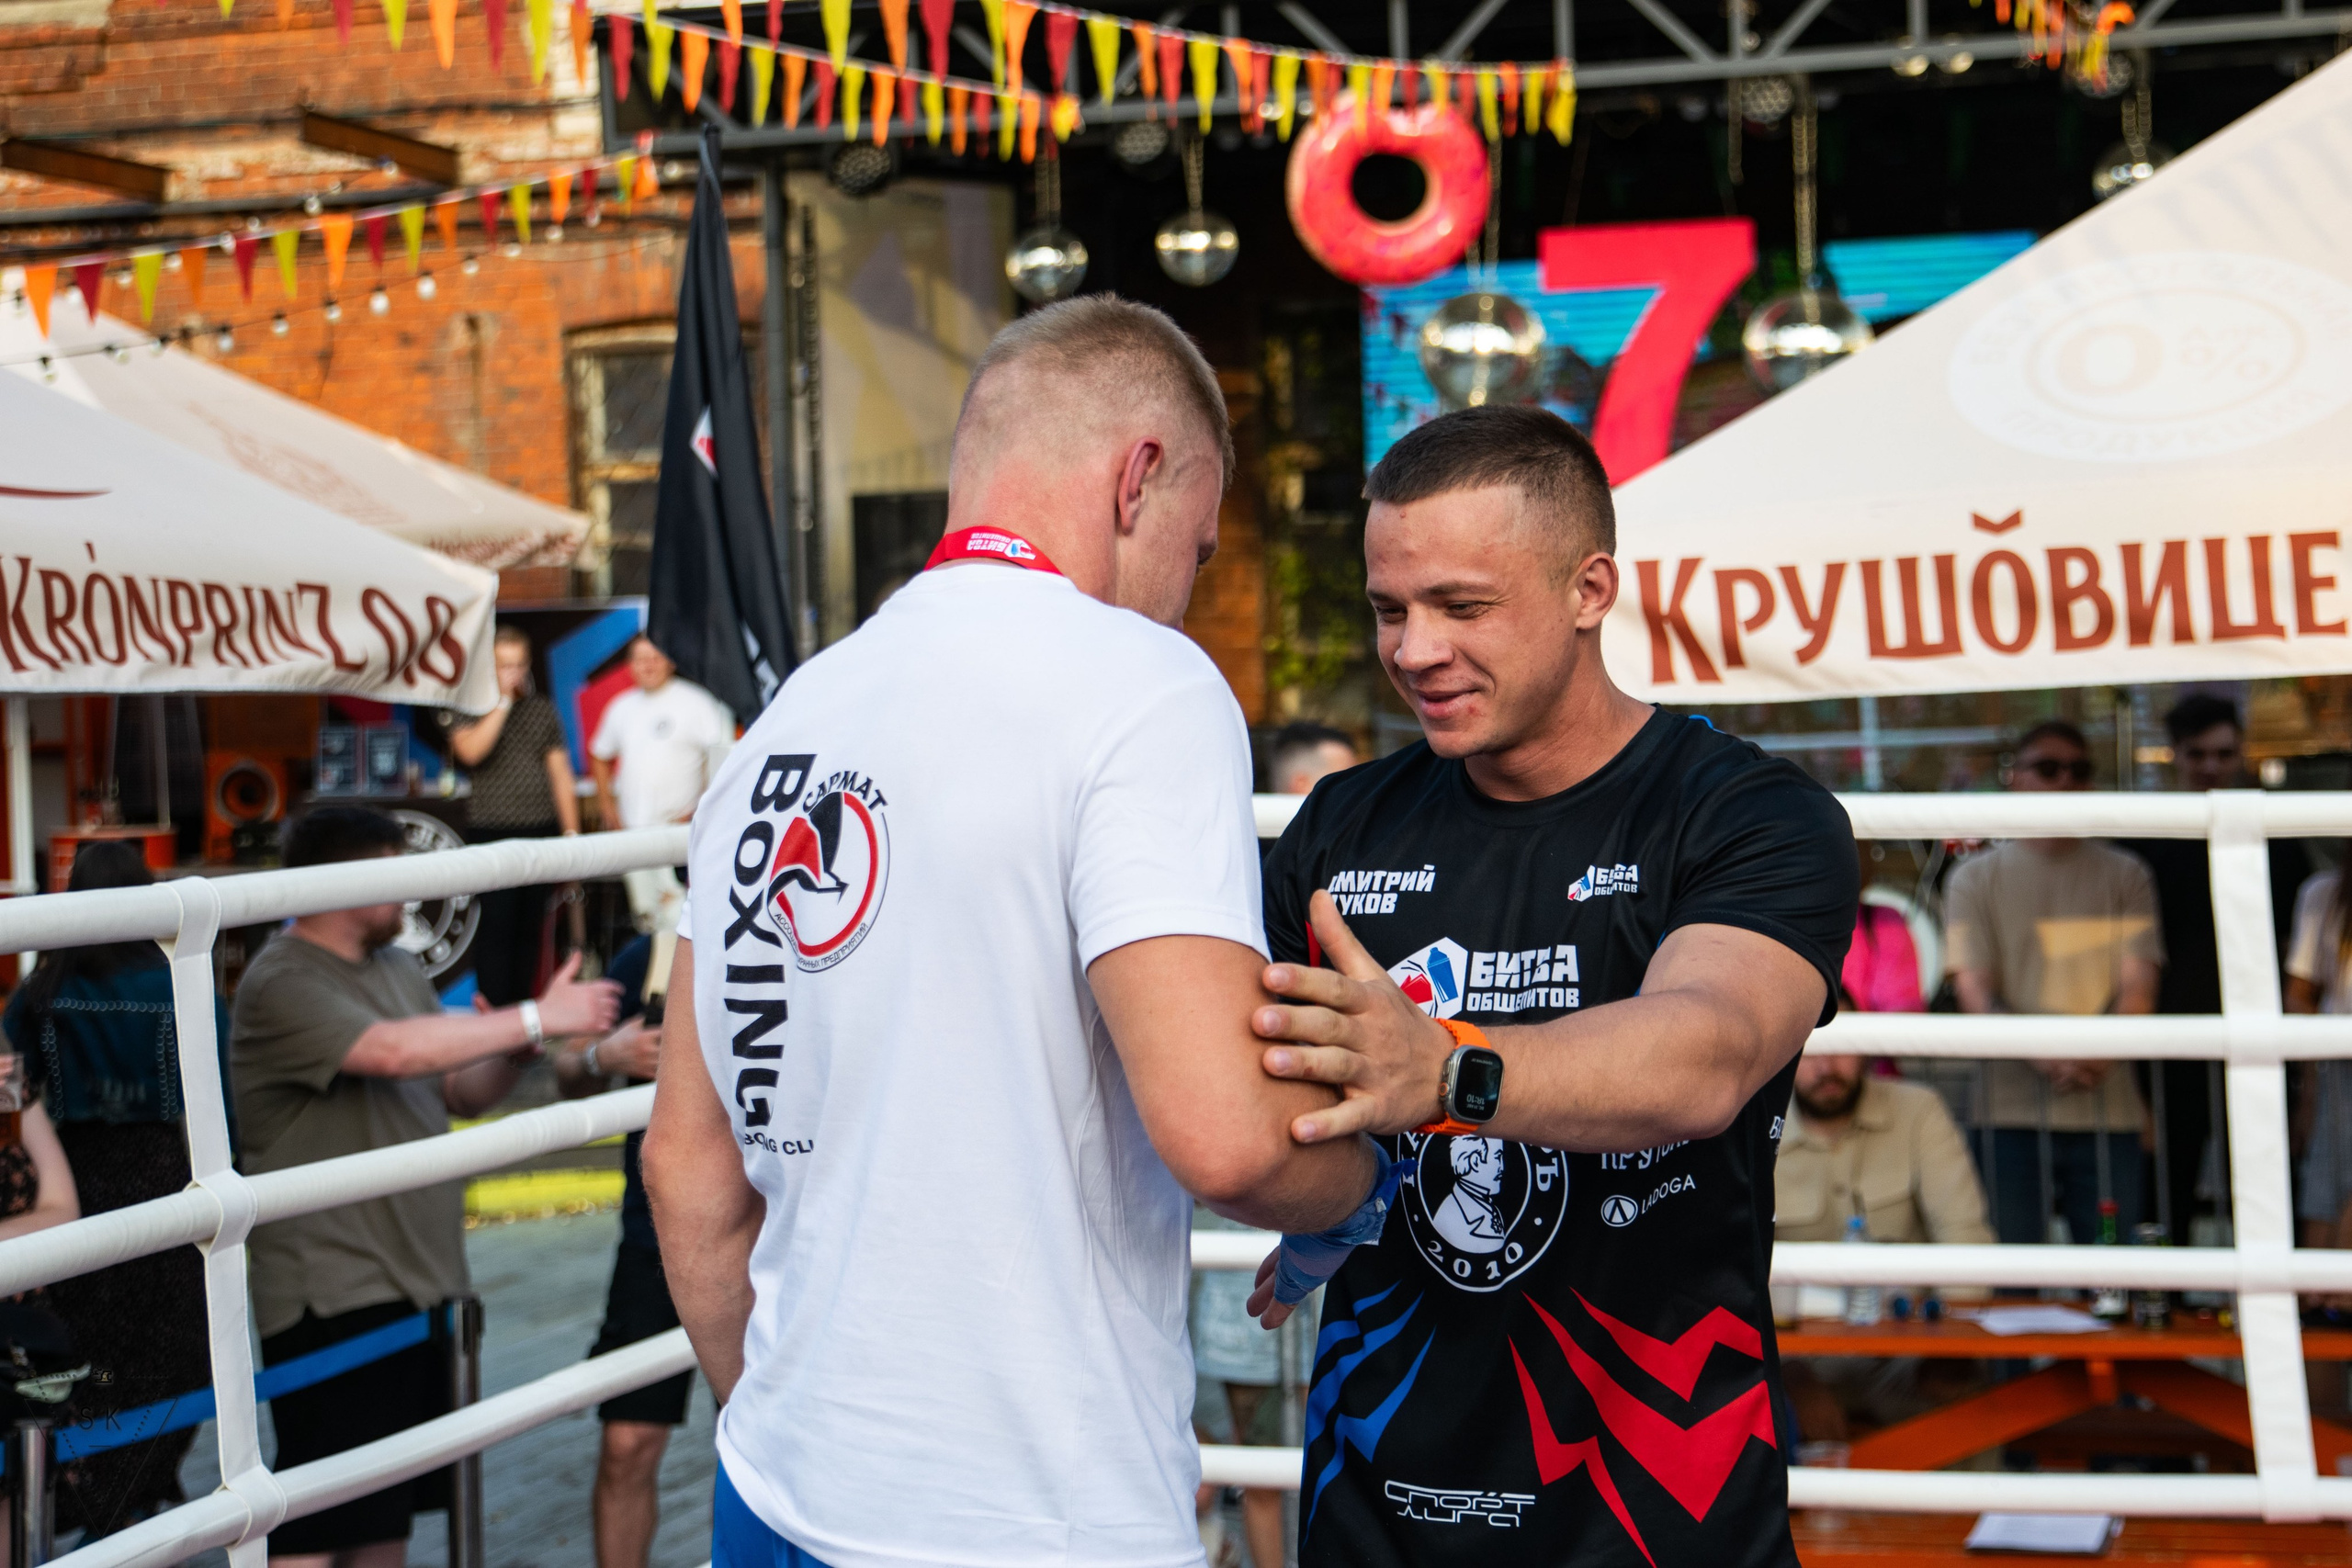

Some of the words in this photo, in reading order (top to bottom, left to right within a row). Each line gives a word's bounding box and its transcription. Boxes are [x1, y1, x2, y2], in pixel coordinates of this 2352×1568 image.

[967, 539, 1007, 552] БИТВА
[802, 771, 888, 813] САРМАТ
[724, 753, 818, 1128] BOXING
[820, 922, 868, 966] ПРЕДПРИЯТИЙ
[1469, 944, 1579, 988] БИТВА
[1466, 987, 1579, 1013] ОБЩЕПИТОВ
[1641, 1174, 1696, 1214] LADOGA
[1427, 1240, 1523, 1280] 2010
